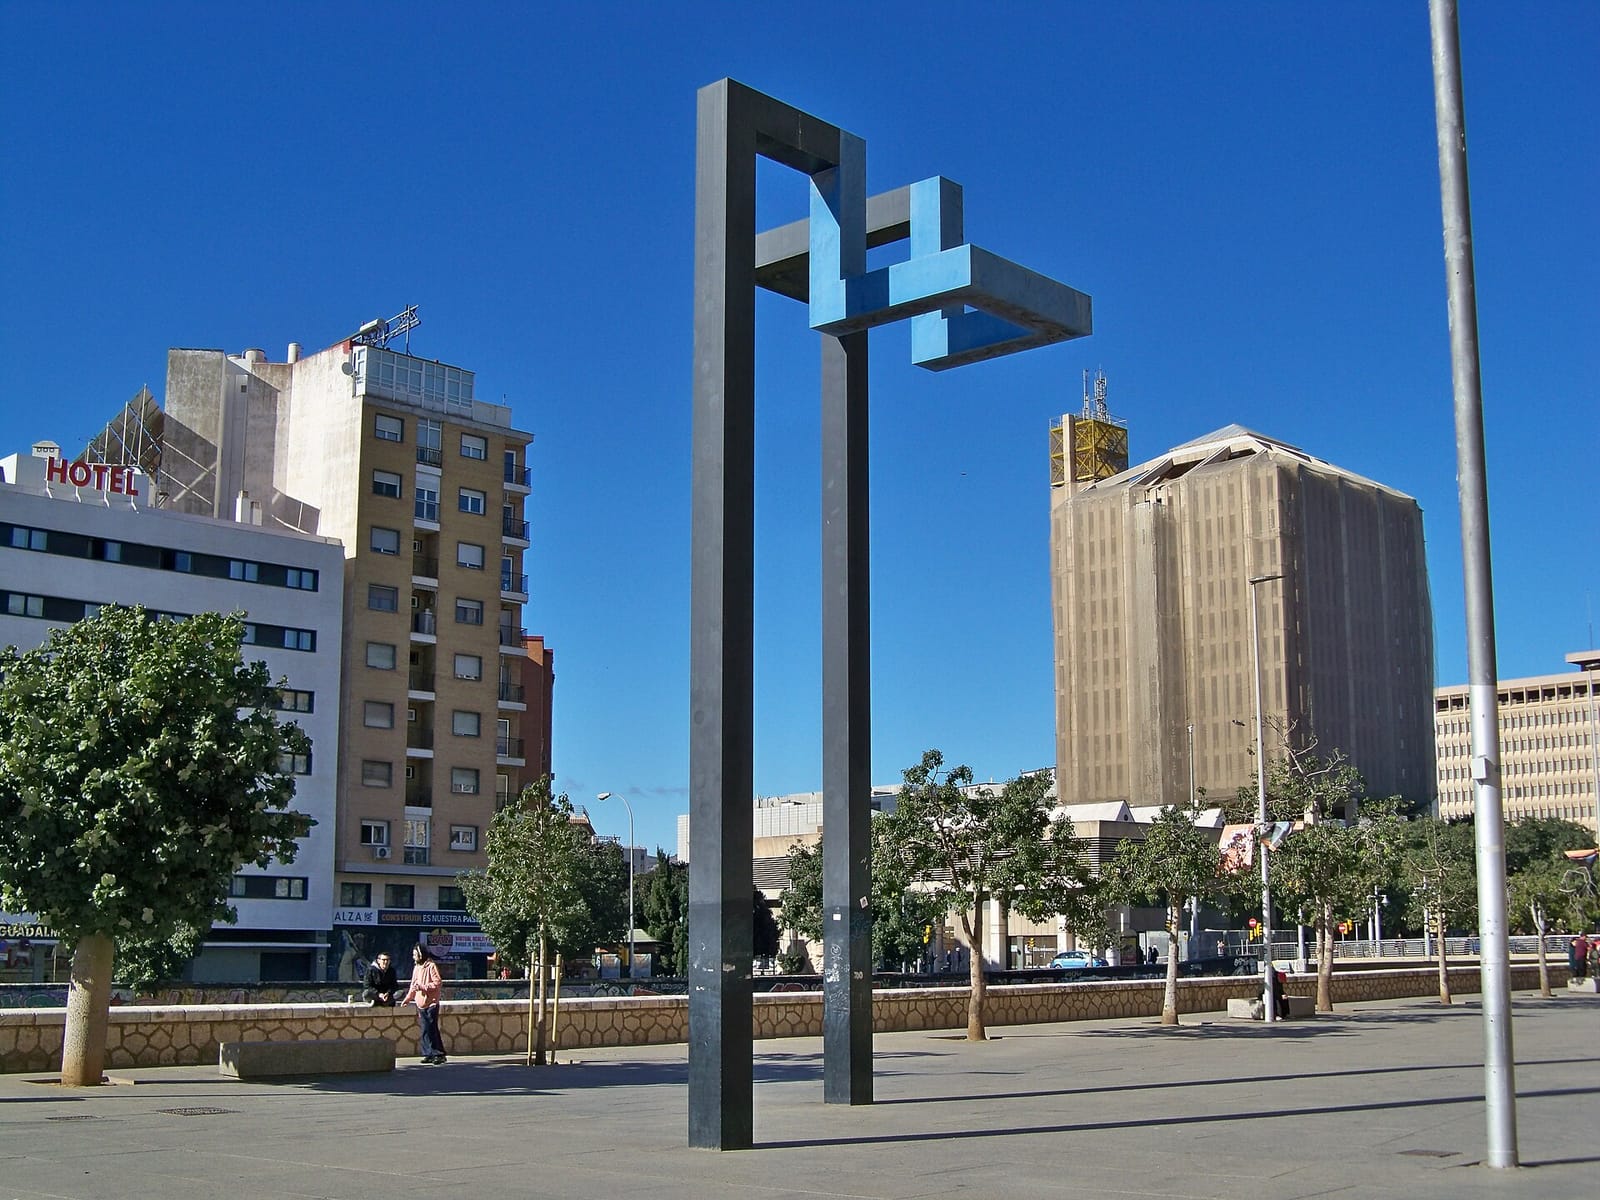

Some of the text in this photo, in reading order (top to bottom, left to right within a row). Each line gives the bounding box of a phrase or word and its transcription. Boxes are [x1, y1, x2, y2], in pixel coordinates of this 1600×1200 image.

[47, 456, 138, 496] HOTEL
[334, 911, 362, 921] ALZA
[423, 914, 431, 922] ES
[432, 915, 461, 923] NUESTRA
